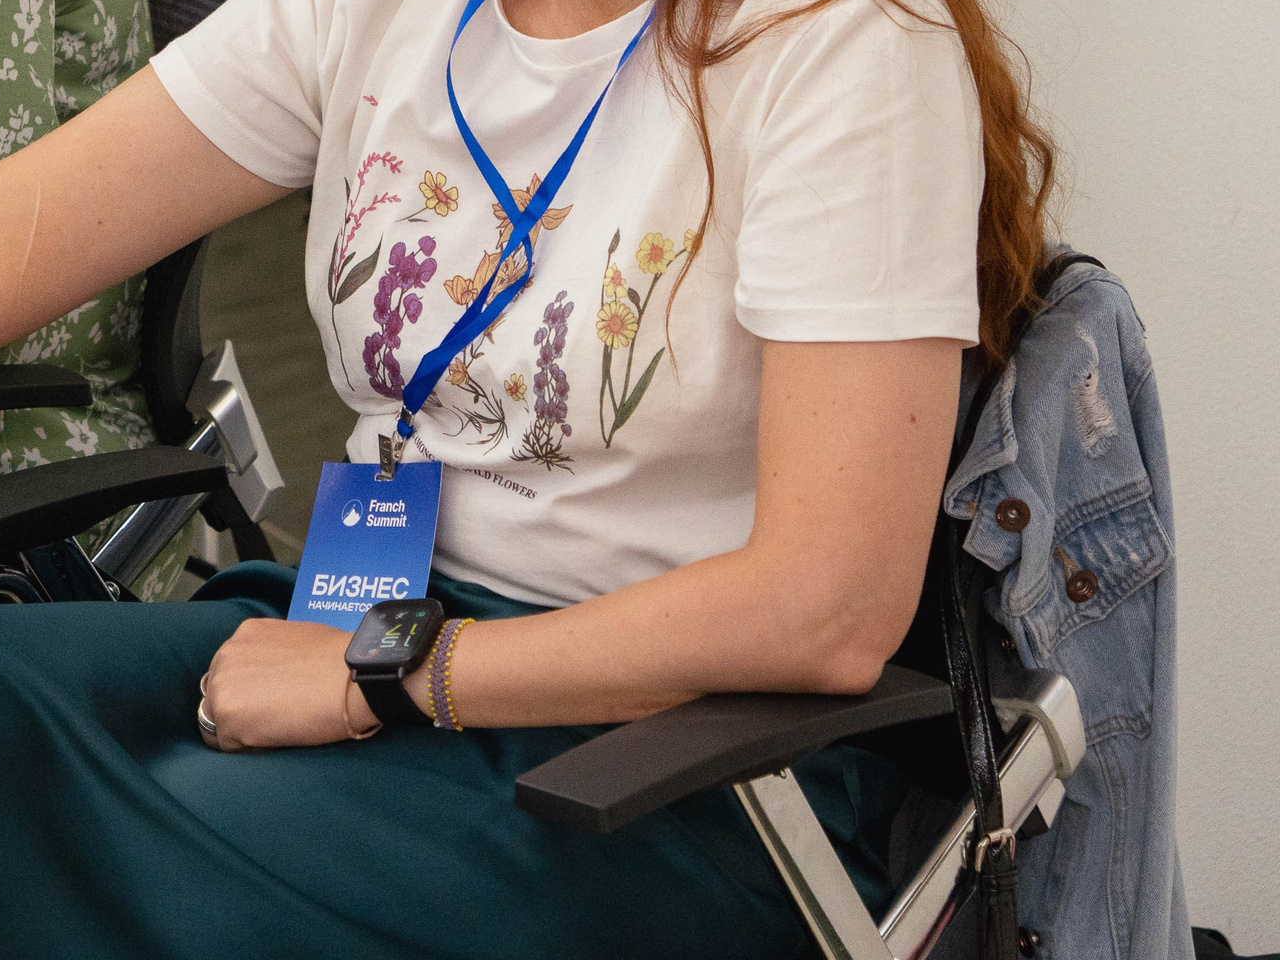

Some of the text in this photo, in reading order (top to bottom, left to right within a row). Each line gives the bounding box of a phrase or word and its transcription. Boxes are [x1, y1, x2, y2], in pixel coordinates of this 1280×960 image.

[492, 472, 538, 500] FLOWERS
[368, 499, 406, 513] Franch
[366, 513, 408, 528] Summit
[312, 574, 410, 600] БИЗНЕС
[308, 600, 373, 613] НАЧИНАЕТСЯ
